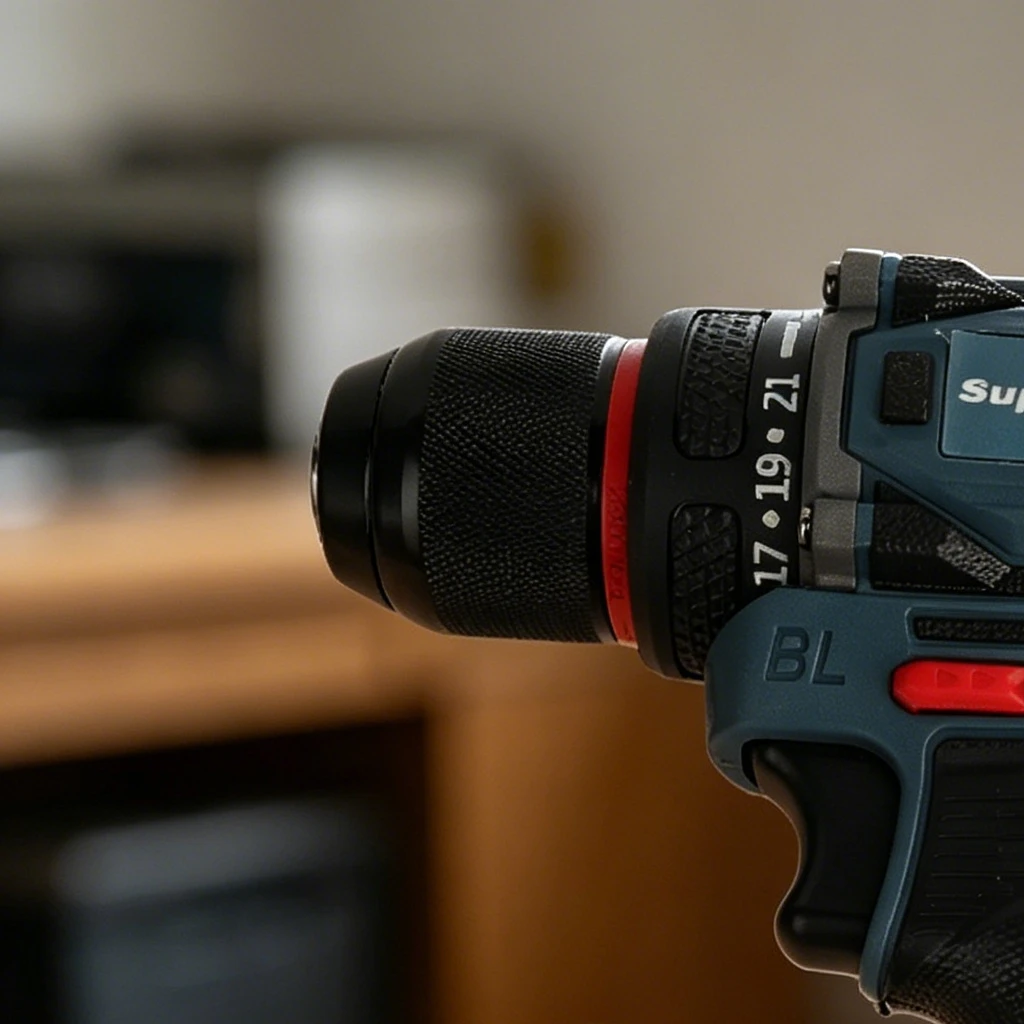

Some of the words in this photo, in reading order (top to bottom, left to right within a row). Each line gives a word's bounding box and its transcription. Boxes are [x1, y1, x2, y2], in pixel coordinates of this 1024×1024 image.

[763, 374, 800, 412] 21
[755, 453, 792, 501] 19
[753, 541, 789, 585] 17
[764, 626, 845, 686] BL
